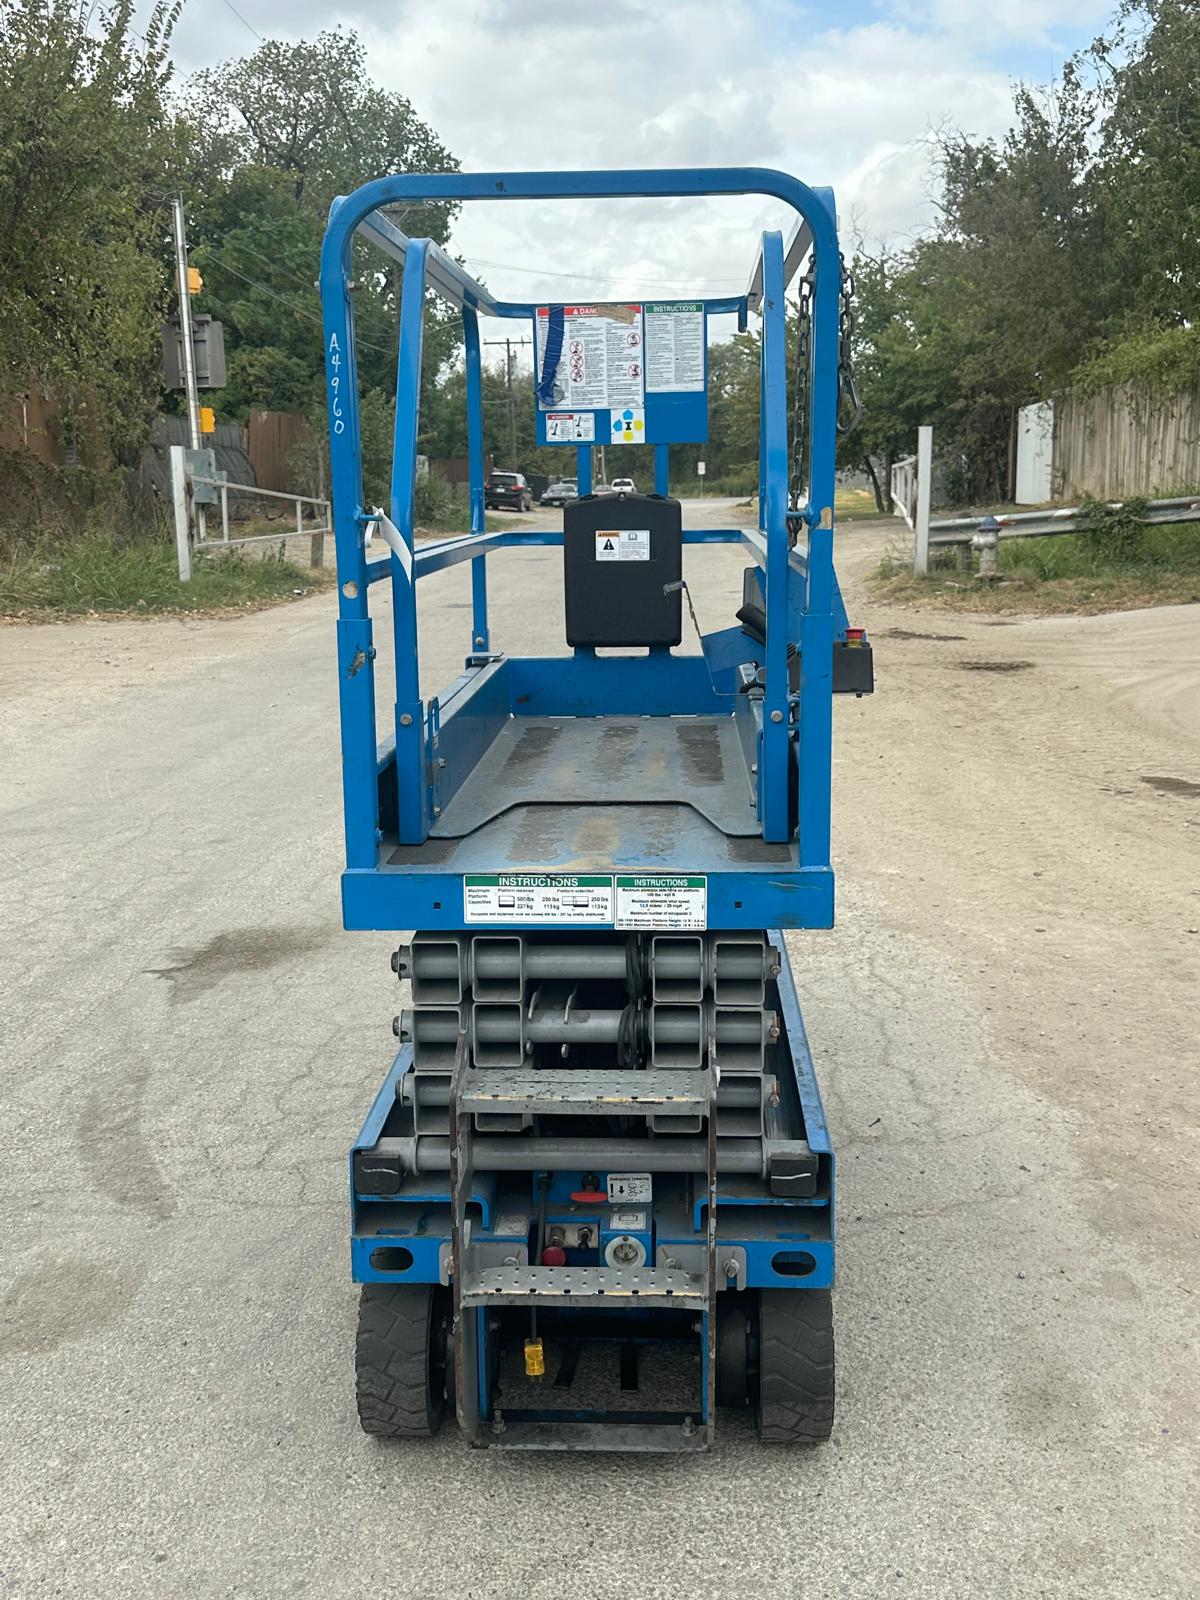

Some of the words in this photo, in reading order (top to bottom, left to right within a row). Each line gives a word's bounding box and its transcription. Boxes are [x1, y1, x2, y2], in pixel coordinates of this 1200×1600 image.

[579, 307, 598, 315] DAN
[653, 304, 697, 313] INSTRUCTIONS
[499, 877, 579, 886] INSTRUCTIONS
[633, 878, 688, 887] INSTRUCTIONS
